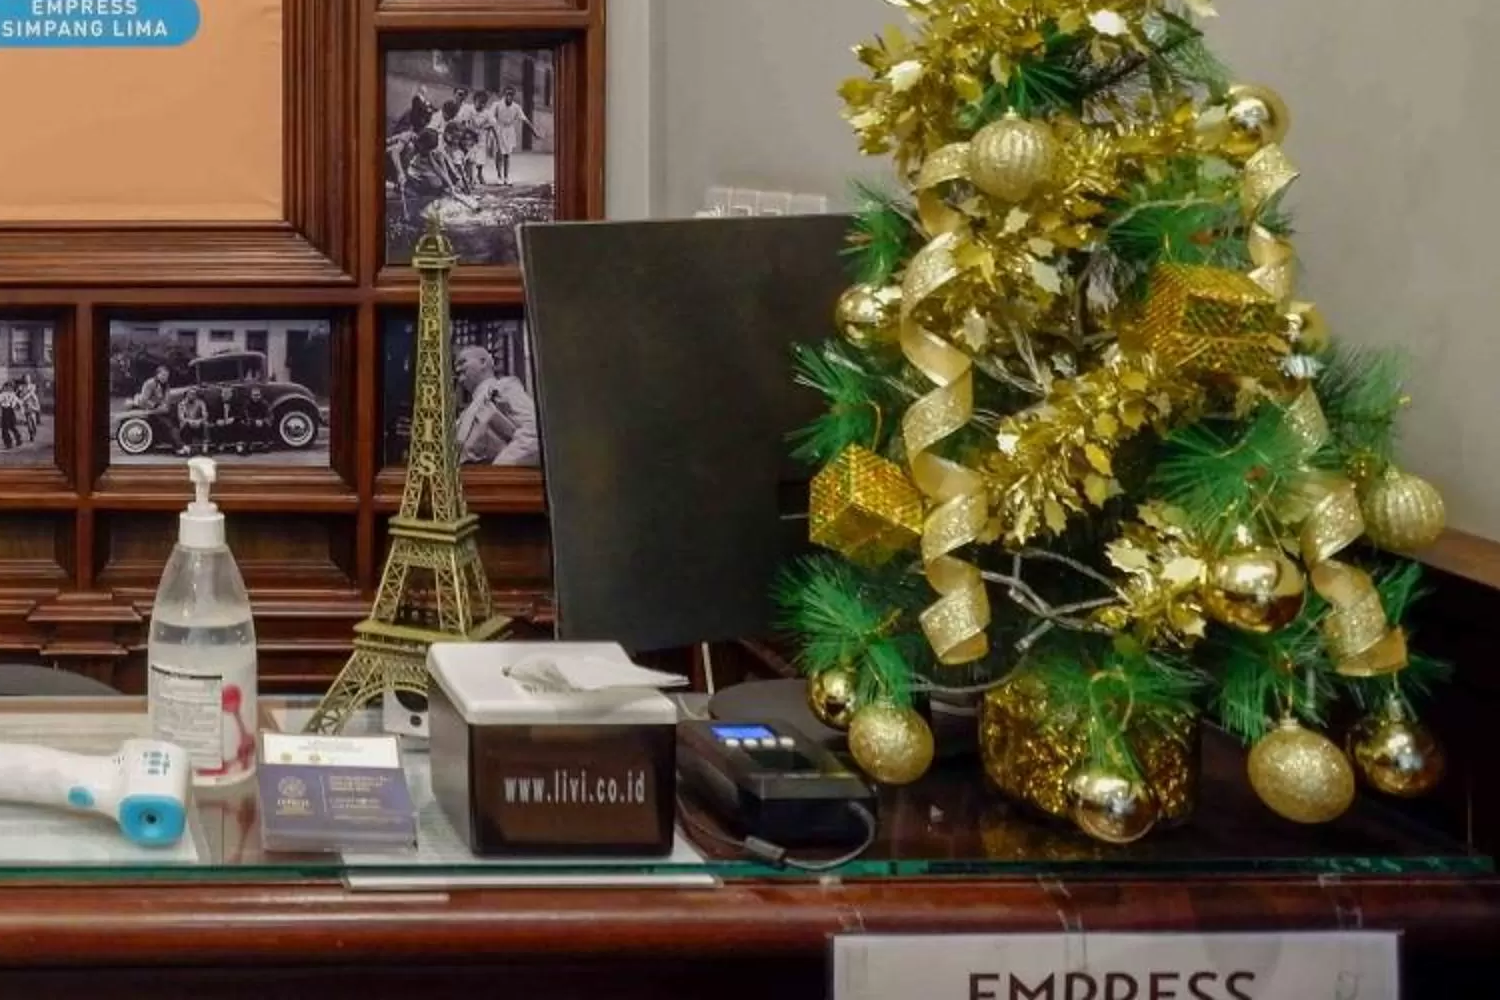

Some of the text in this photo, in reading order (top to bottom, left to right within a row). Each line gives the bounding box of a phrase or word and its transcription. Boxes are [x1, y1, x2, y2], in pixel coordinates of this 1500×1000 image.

[1, 20, 168, 38] SIMPANG LIMA
[418, 318, 438, 476] PARIS
[503, 769, 645, 804] www.livi.co.id
